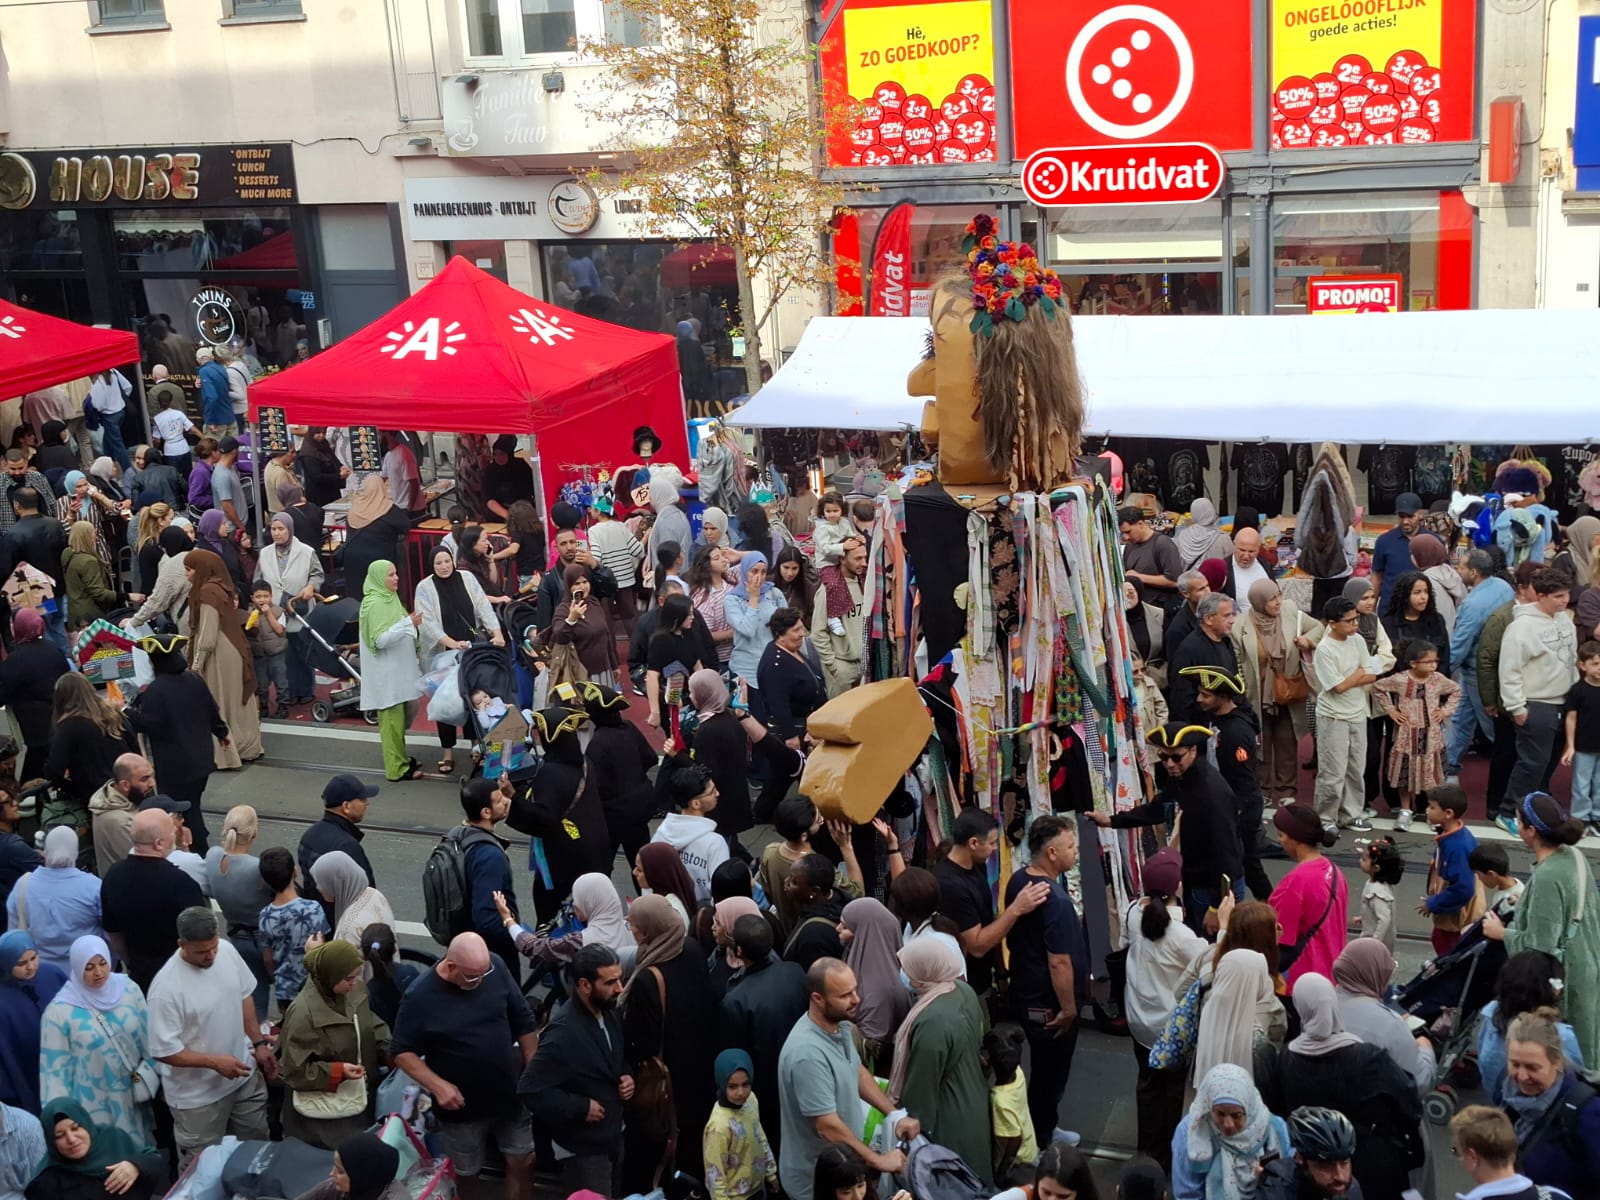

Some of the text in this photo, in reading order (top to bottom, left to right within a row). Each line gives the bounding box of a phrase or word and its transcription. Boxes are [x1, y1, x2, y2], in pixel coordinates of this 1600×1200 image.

[906, 26, 926, 40] Hè,
[1309, 14, 1397, 41] goede acties!
[860, 33, 980, 68] ZO GOEDKOOP?
[1413, 73, 1440, 91] 2+1
[1279, 86, 1314, 104] 50%
[906, 100, 928, 119] 1+1
[943, 99, 968, 116] 2+1
[1364, 104, 1398, 120] 50%
[879, 121, 904, 134] 25%
[905, 126, 933, 141] 50%
[956, 121, 985, 139] 3+2
[1283, 123, 1312, 140] 2+1
[1402, 125, 1431, 141] 25%
[1316, 130, 1346, 147] 3+2
[1364, 132, 1393, 146] 1+1
[235, 149, 272, 159] ONTBIJT
[864, 150, 891, 166] 3+2
[943, 146, 967, 159] 25%
[237, 162, 266, 172] LUNCH
[1071, 157, 1210, 192] Kruidvat
[50, 153, 201, 203] HOUSE
[239, 175, 279, 186] DESSERTS
[240, 188, 293, 199] MUCH MORE
[413, 201, 493, 217] PANNEKOEKENHUIS
[500, 200, 537, 215] ONTBIJT
[192, 290, 232, 309] TWINS
[1317, 286, 1391, 306] PROMO!
